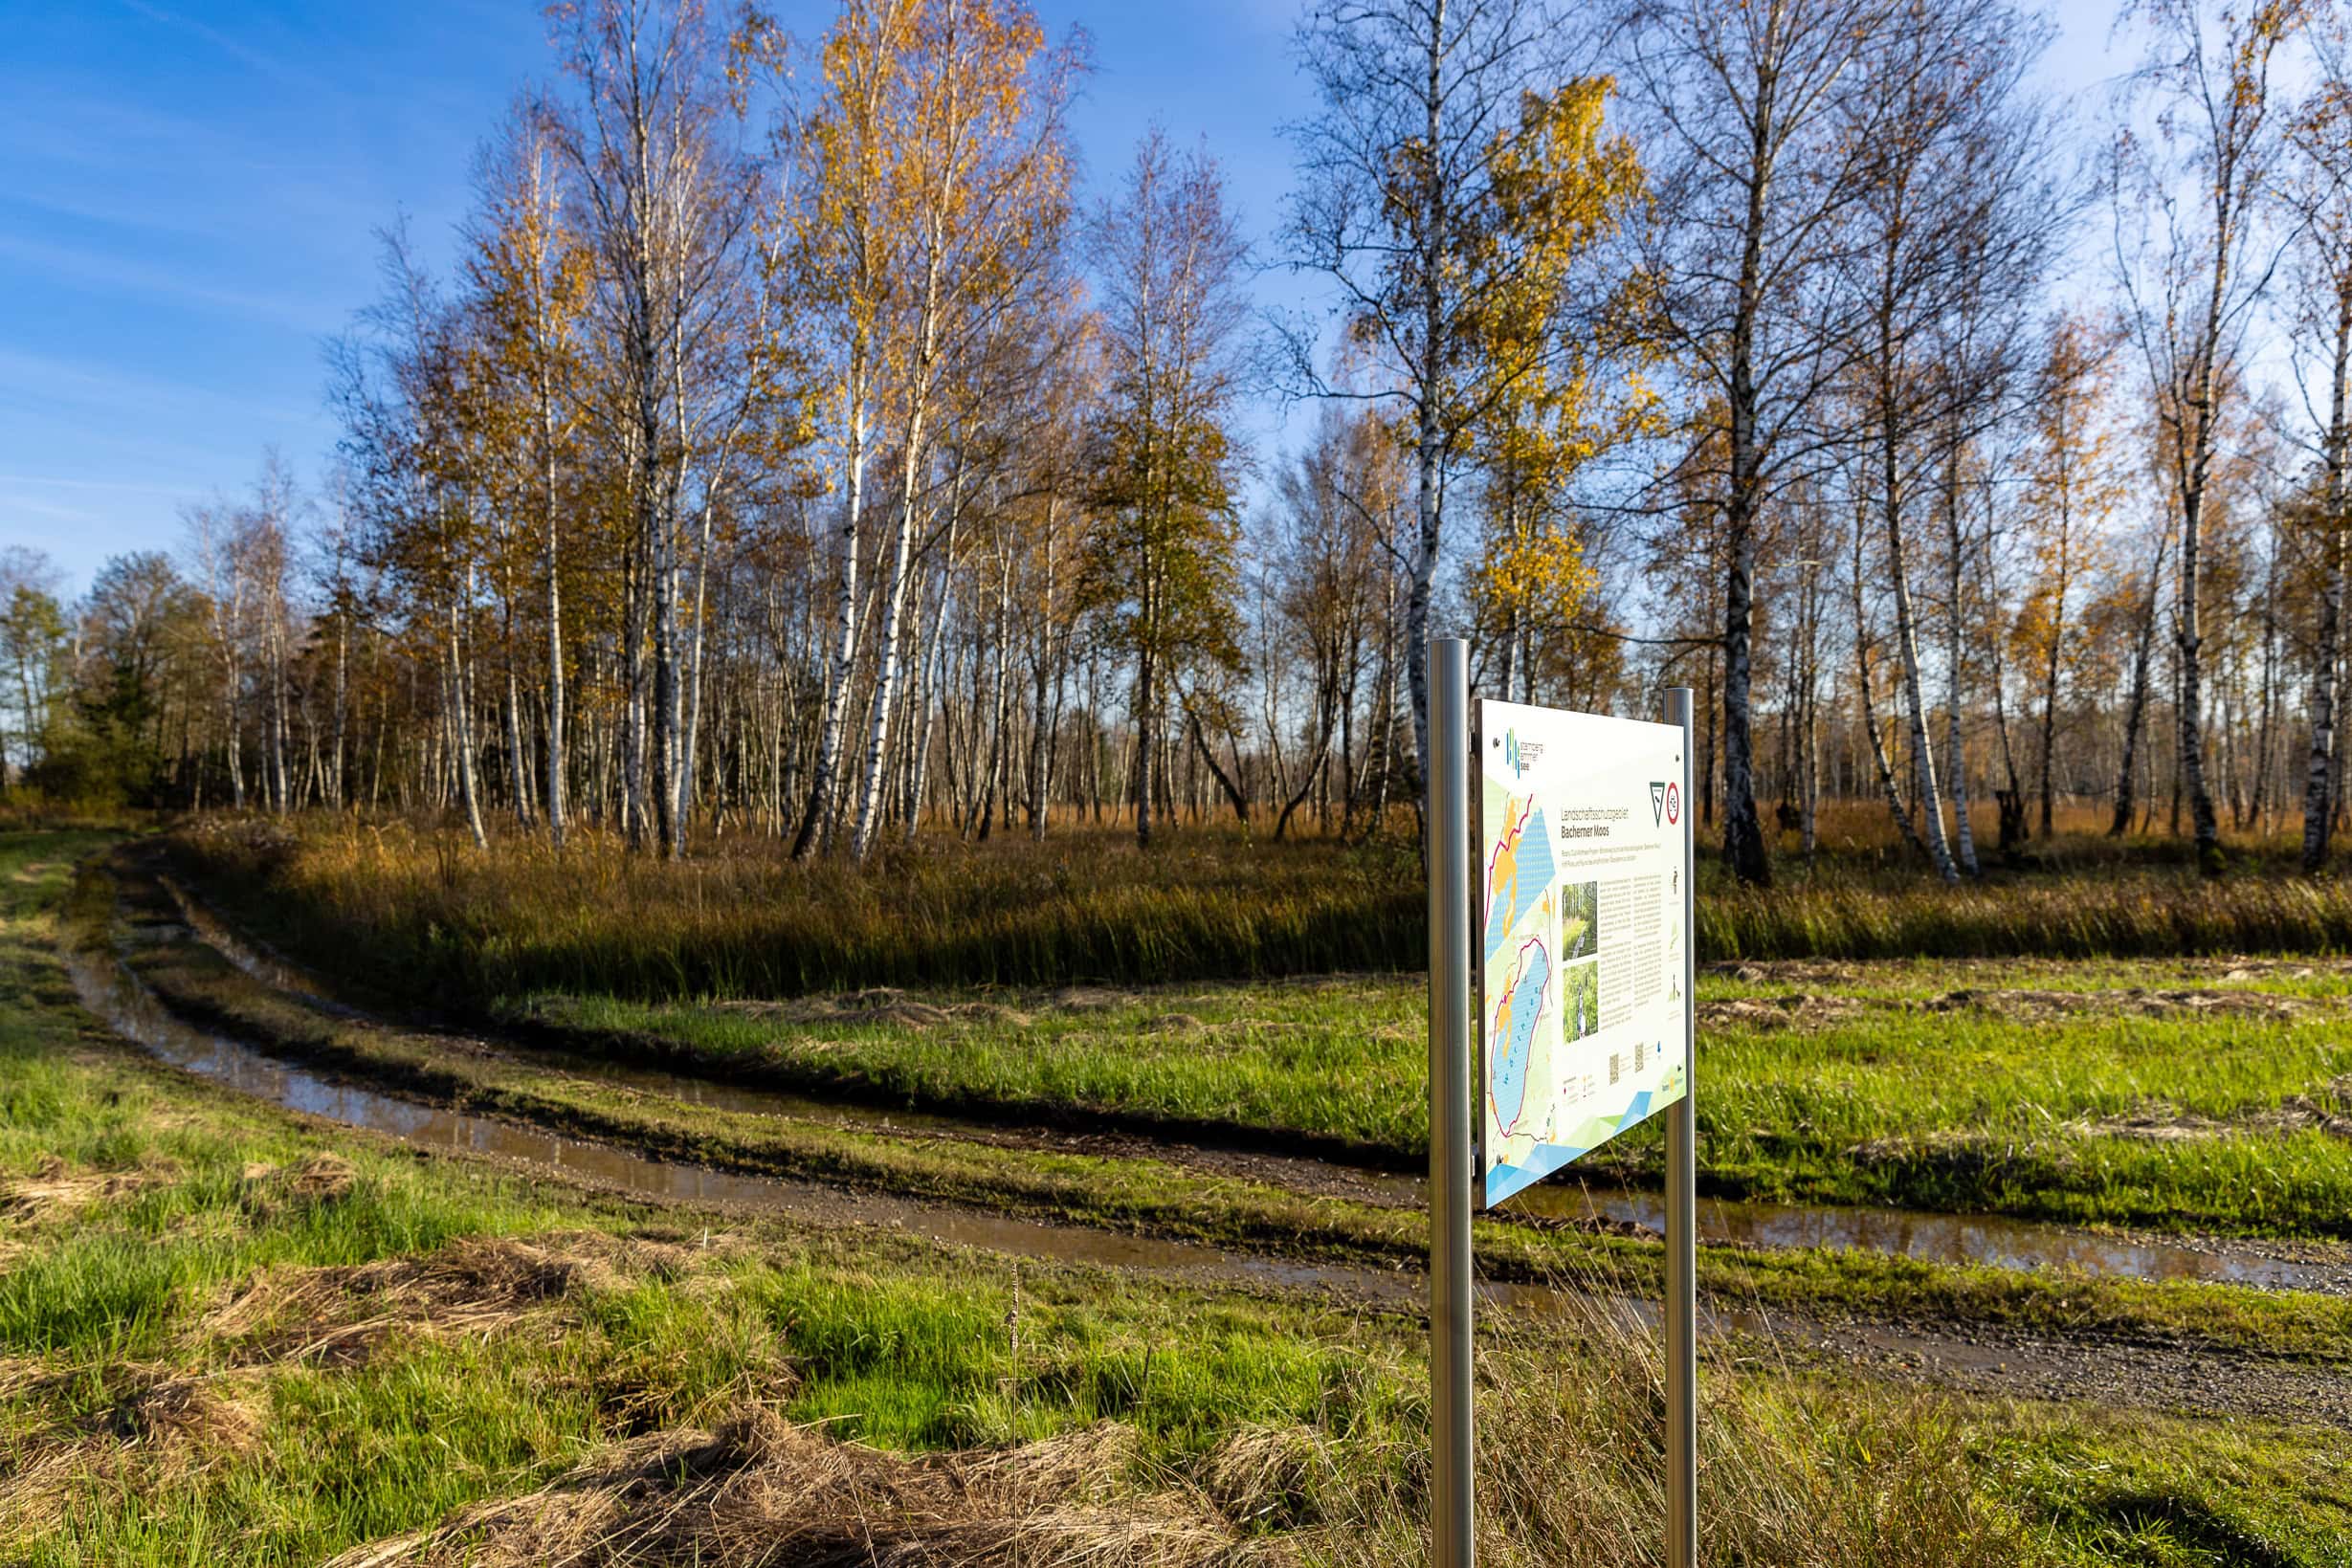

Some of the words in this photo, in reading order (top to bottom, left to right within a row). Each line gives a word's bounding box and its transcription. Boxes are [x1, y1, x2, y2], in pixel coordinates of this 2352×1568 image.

[1520, 762, 1530, 771] see
[1561, 806, 1629, 822] Landschaftsschutzgebiet
[1561, 825, 1593, 839] Bacherner
[1593, 824, 1609, 837] Moos
